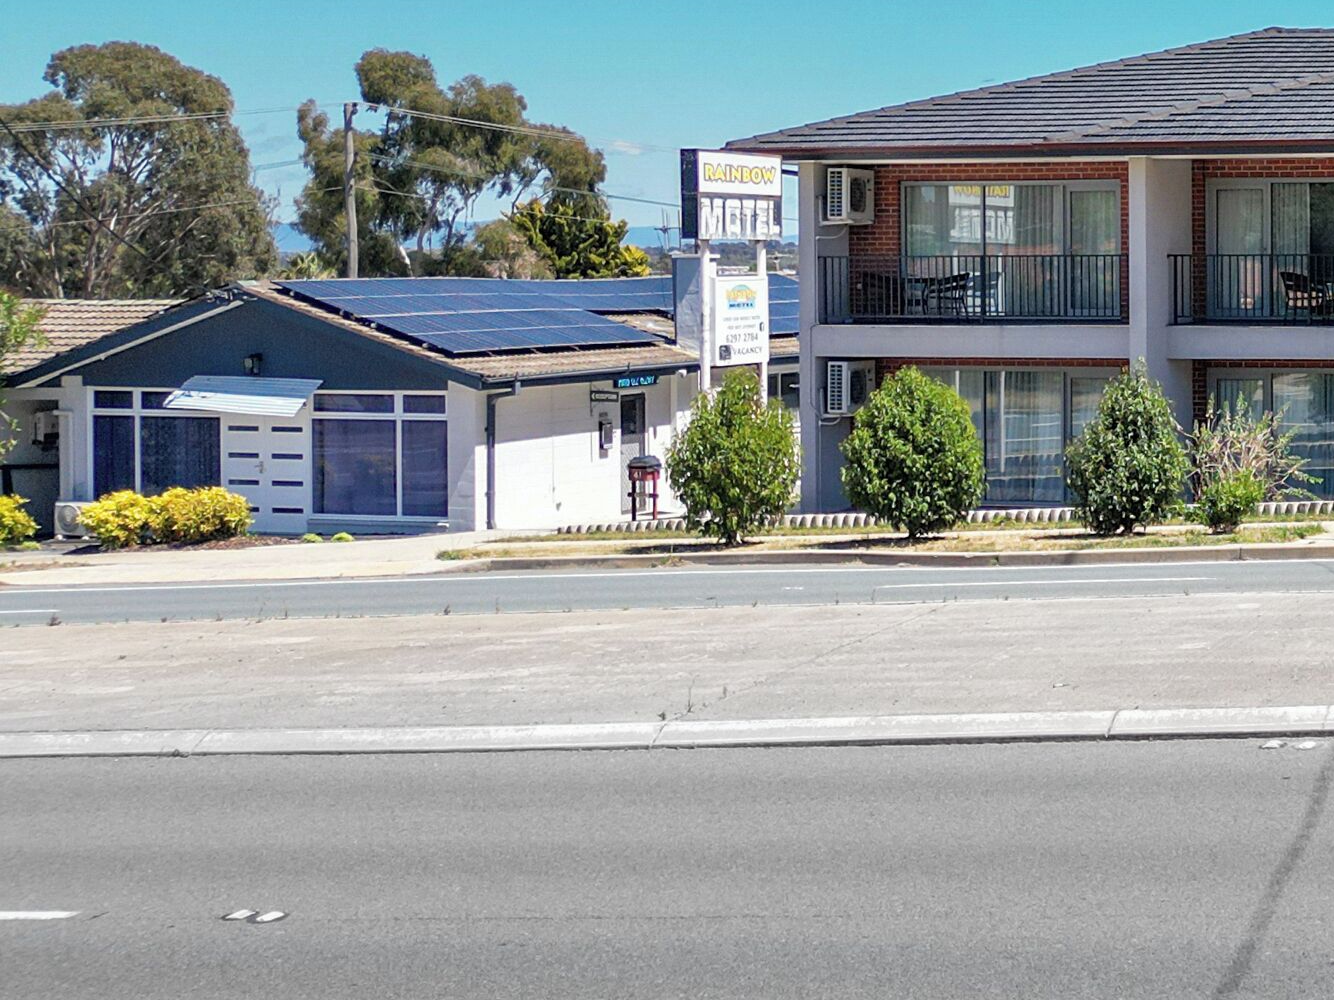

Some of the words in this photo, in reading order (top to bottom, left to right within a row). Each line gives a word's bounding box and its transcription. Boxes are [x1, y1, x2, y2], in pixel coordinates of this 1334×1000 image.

[704, 162, 776, 185] RAINBOW
[701, 197, 780, 239] MOTEL
[733, 346, 763, 356] VACANCY
